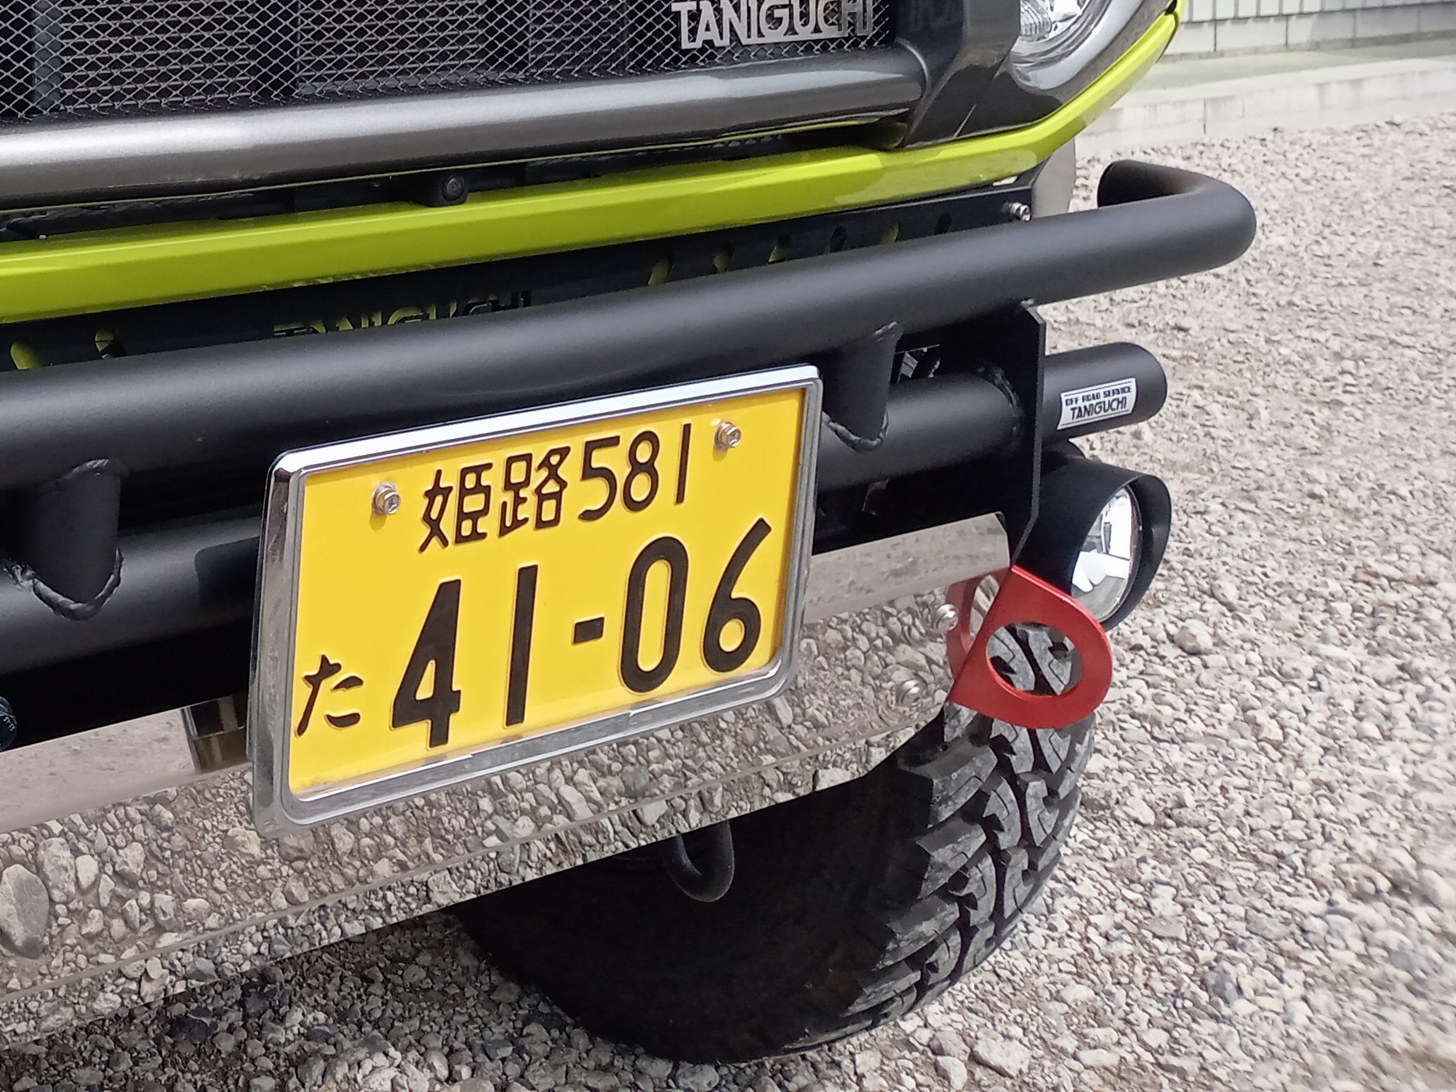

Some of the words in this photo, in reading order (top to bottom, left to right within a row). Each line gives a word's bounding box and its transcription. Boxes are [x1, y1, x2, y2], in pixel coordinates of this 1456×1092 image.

[1065, 397, 1079, 406] OFF
[1082, 392, 1101, 403] ROAD
[1103, 386, 1131, 398] SERVICE
[1070, 396, 1127, 420] TANIGUCHI
[296, 653, 364, 736] た
[390, 516, 774, 748] 41-06
